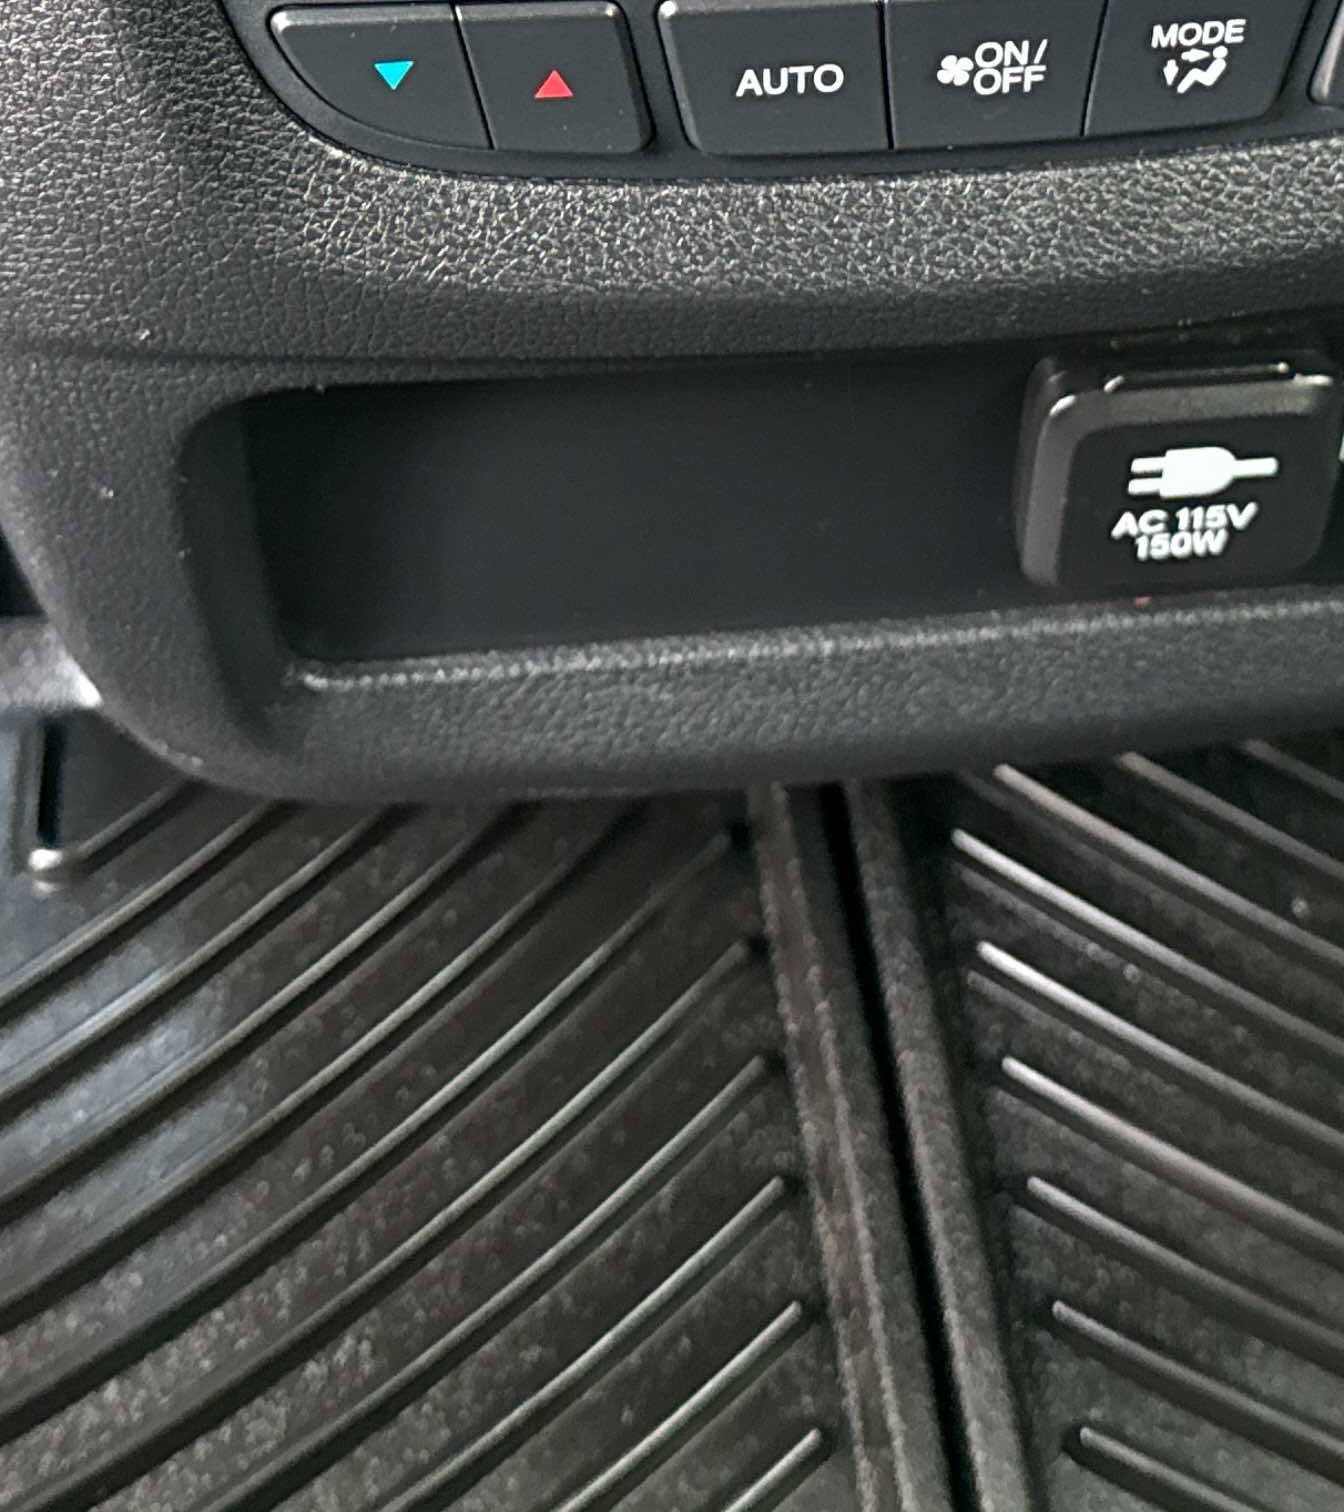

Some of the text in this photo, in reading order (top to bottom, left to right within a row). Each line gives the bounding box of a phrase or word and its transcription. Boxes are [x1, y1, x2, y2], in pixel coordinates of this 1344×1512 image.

[1151, 18, 1247, 49] MODE
[974, 39, 1048, 66] ON/
[735, 64, 845, 98] AUTO
[973, 65, 1047, 96] OFF
[1111, 502, 1258, 540] AC 115V
[1133, 529, 1228, 561] 150W
